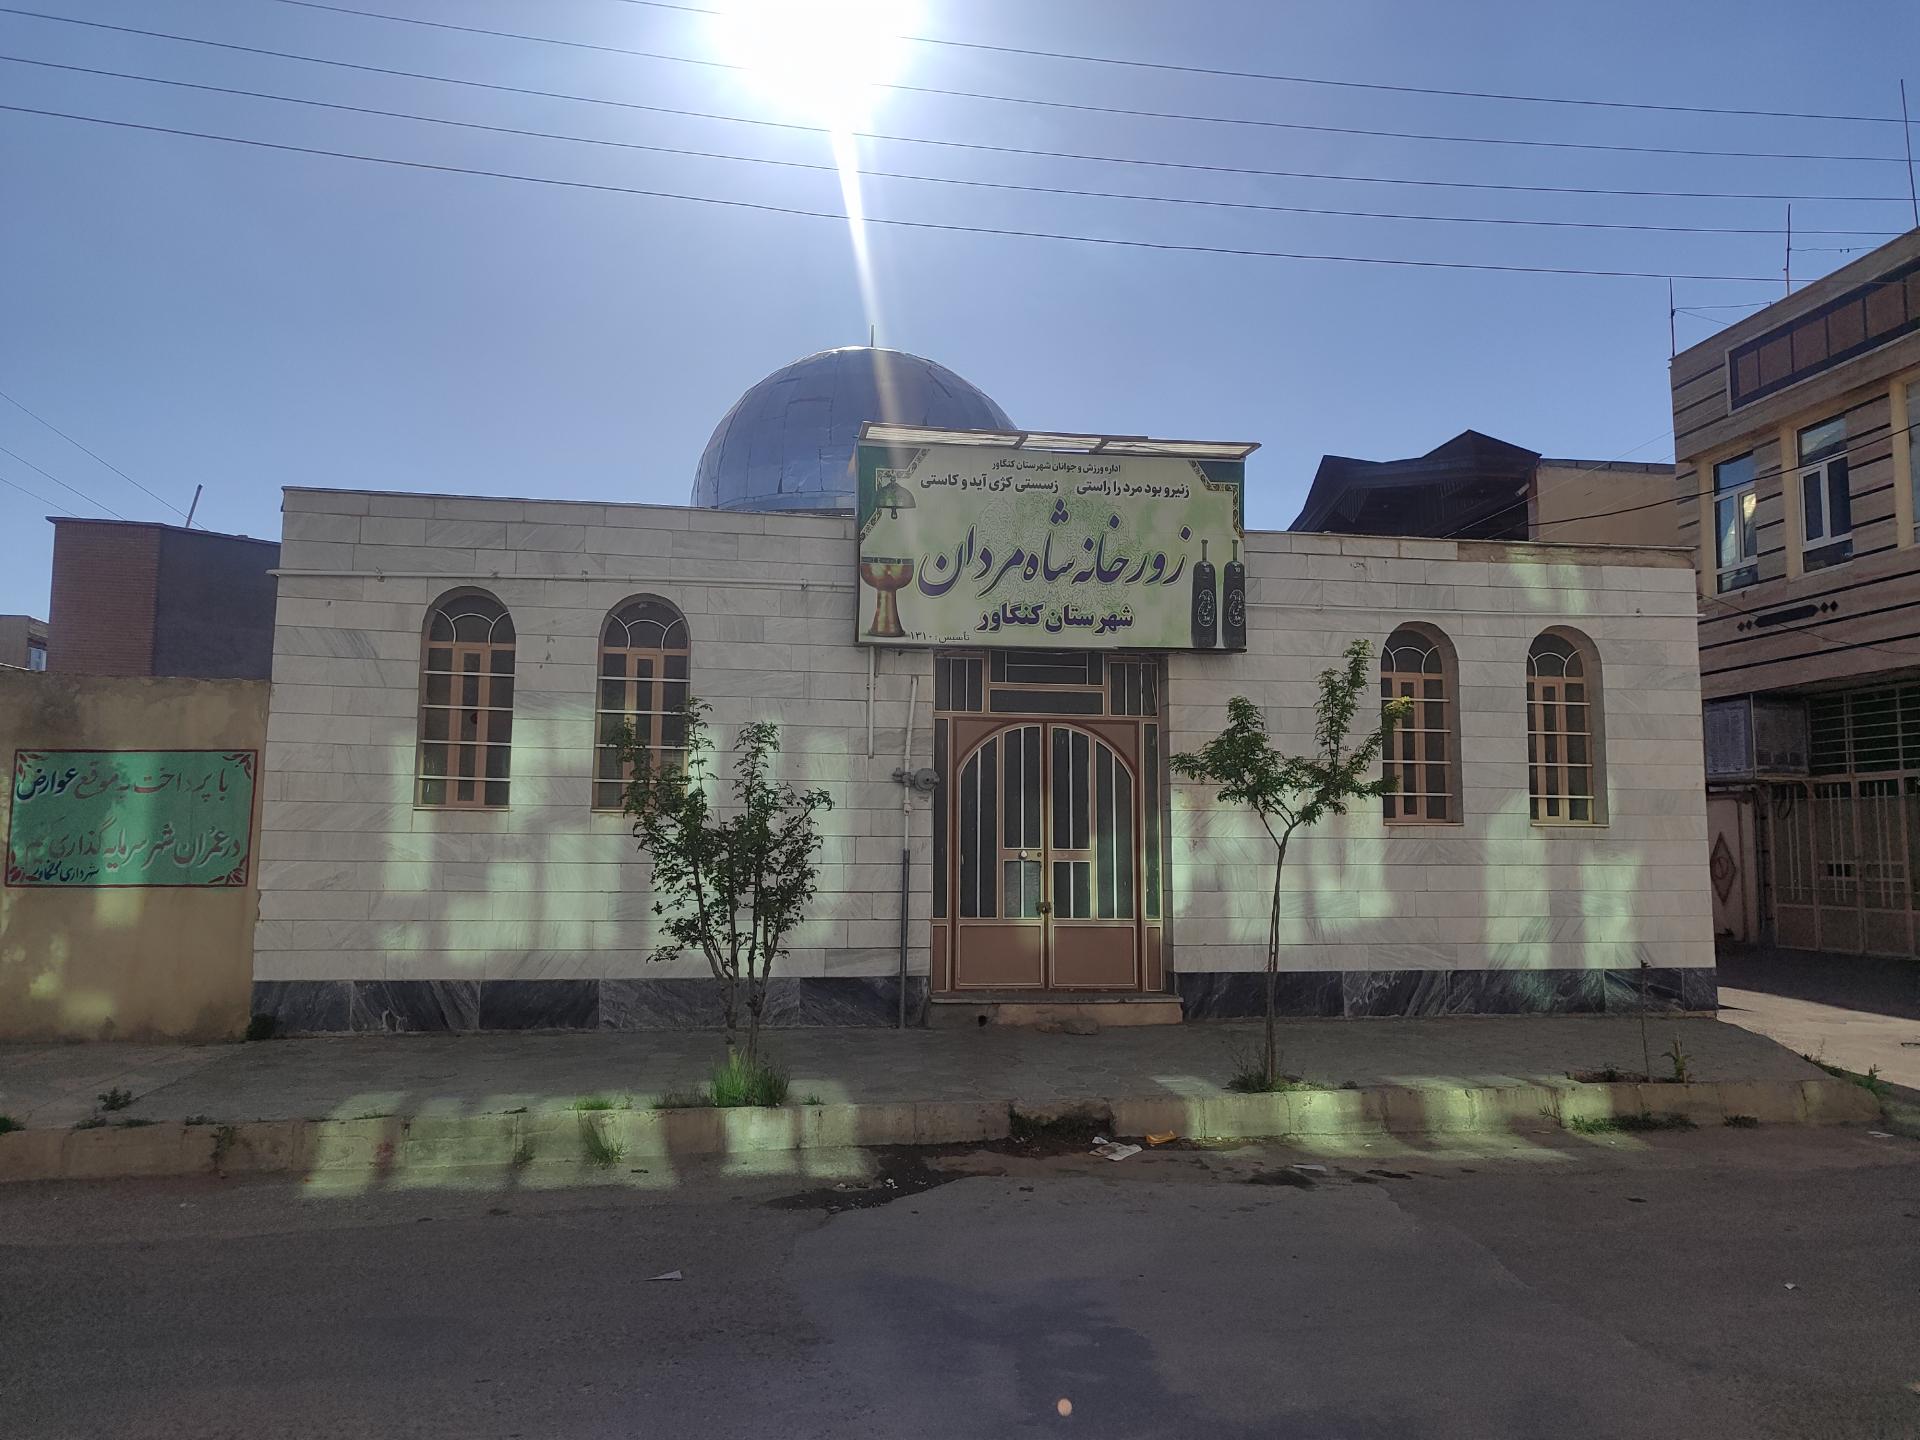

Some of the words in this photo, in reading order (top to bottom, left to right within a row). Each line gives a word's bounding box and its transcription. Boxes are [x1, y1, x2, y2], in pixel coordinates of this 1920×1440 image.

[992, 459, 1015, 470] کنگاور
[1016, 460, 1051, 471] شهرستان
[1052, 462, 1077, 472] جوانان
[1083, 464, 1104, 474] ورزش
[1104, 464, 1121, 474] اداره
[920, 473, 959, 488] کاستی
[961, 479, 968, 490] و
[970, 473, 988, 490] آید
[989, 476, 1013, 491] کژی
[1076, 480, 1111, 495] راستی
[1113, 480, 1121, 496] را
[1123, 482, 1143, 496] مرد
[1144, 484, 1162, 497] بود
[1022, 498, 1076, 582] شاه
[918, 524, 1026, 598] مردان
[976, 602, 1044, 631] کنگاور
[1044, 604, 1134, 634] شهرستان
[910, 631, 932, 641] ۱۳۱۰
[16, 767, 80, 801] عوارض
[73, 761, 119, 800] موقع
[219, 768, 229, 802] با
[140, 821, 177, 870] شهر
[221, 839, 241, 858] در
[60, 865, 100, 882] شهرداری
